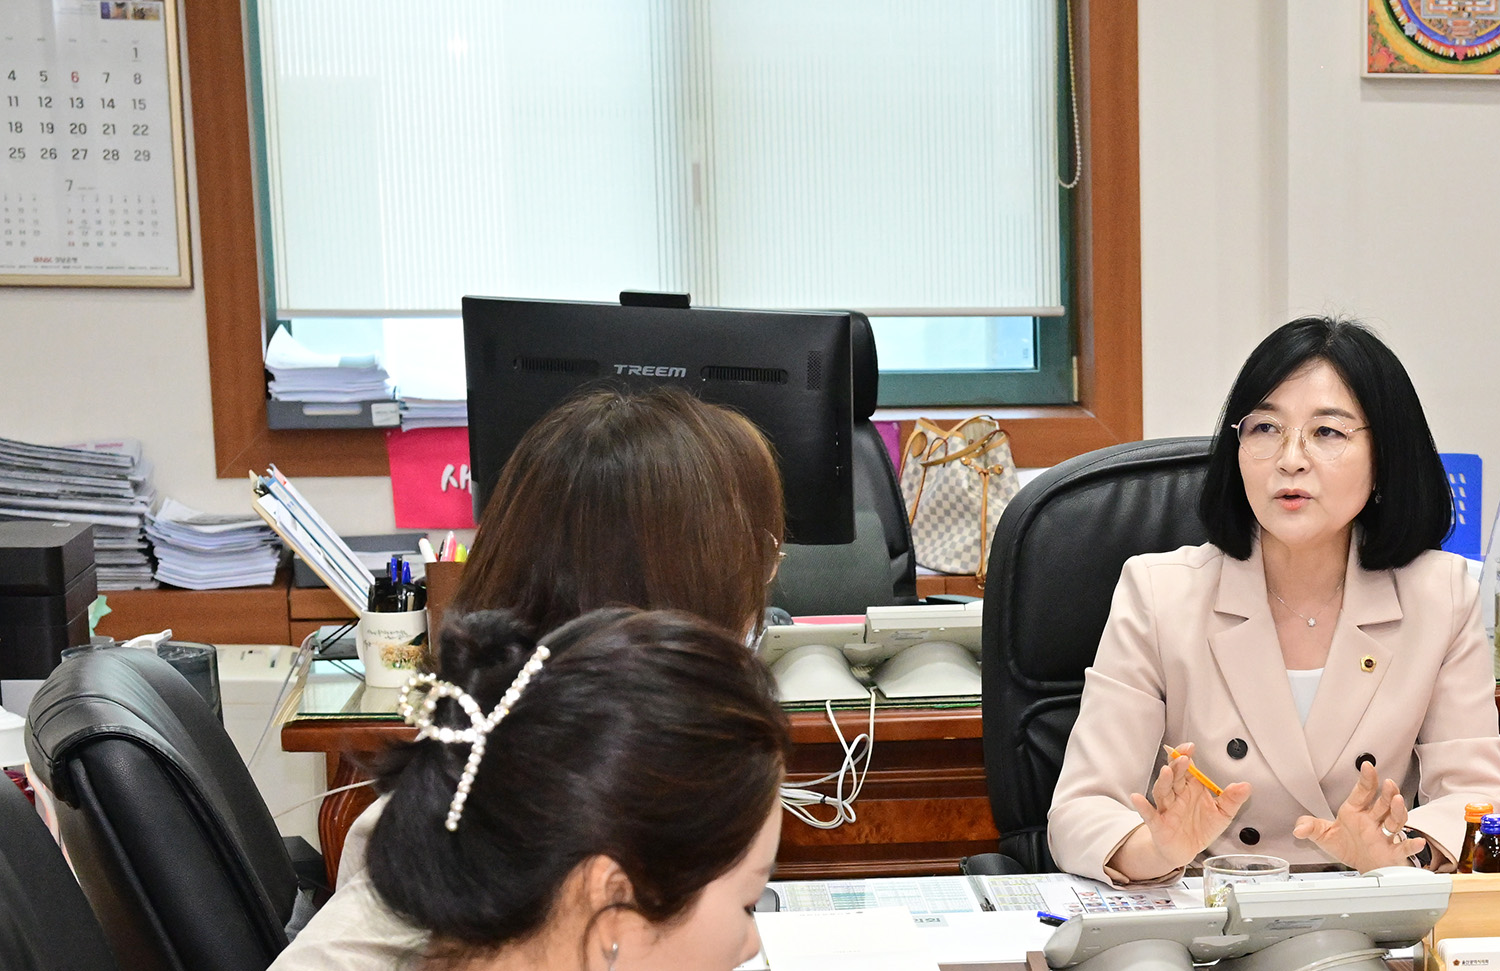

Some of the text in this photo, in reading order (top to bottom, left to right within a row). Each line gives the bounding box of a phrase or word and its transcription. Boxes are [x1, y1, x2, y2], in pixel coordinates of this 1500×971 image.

[132, 47, 139, 59] 1
[8, 70, 142, 85] 4 5 6 7 8
[8, 96, 146, 110] 11 12 13 14 15
[8, 122, 149, 136] 18 19 20 21 22
[9, 148, 151, 162] 25 26 27 28 29
[65, 180, 73, 191] 7
[614, 364, 687, 378] TREEM
